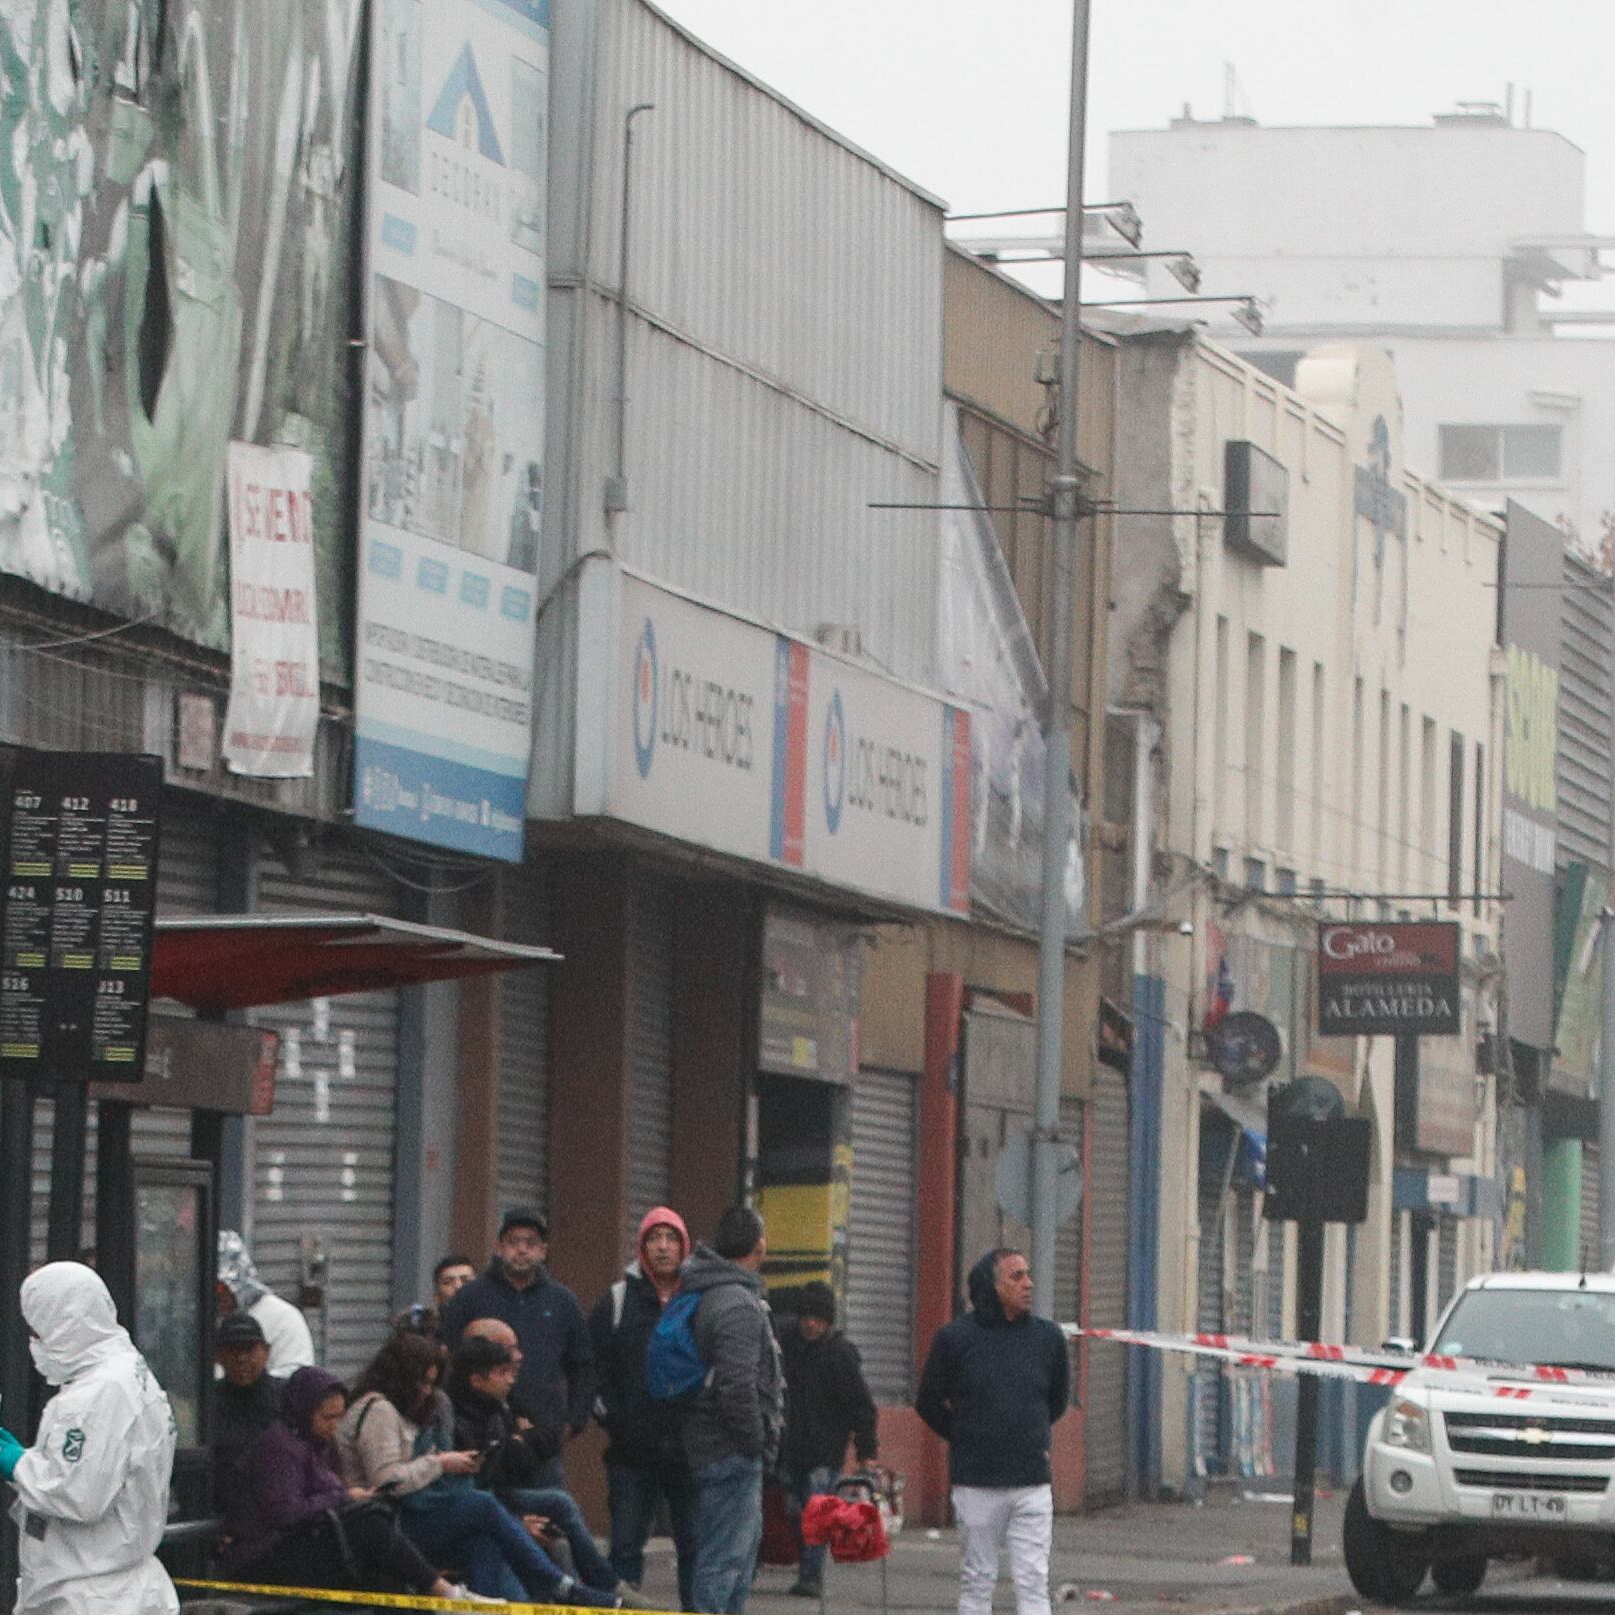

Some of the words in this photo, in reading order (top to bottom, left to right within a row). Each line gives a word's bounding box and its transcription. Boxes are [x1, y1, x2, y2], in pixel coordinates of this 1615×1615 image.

[62, 796, 89, 811] 412
[1321, 925, 1397, 961] Gato
[1327, 997, 1453, 1018] ALAMEDA
